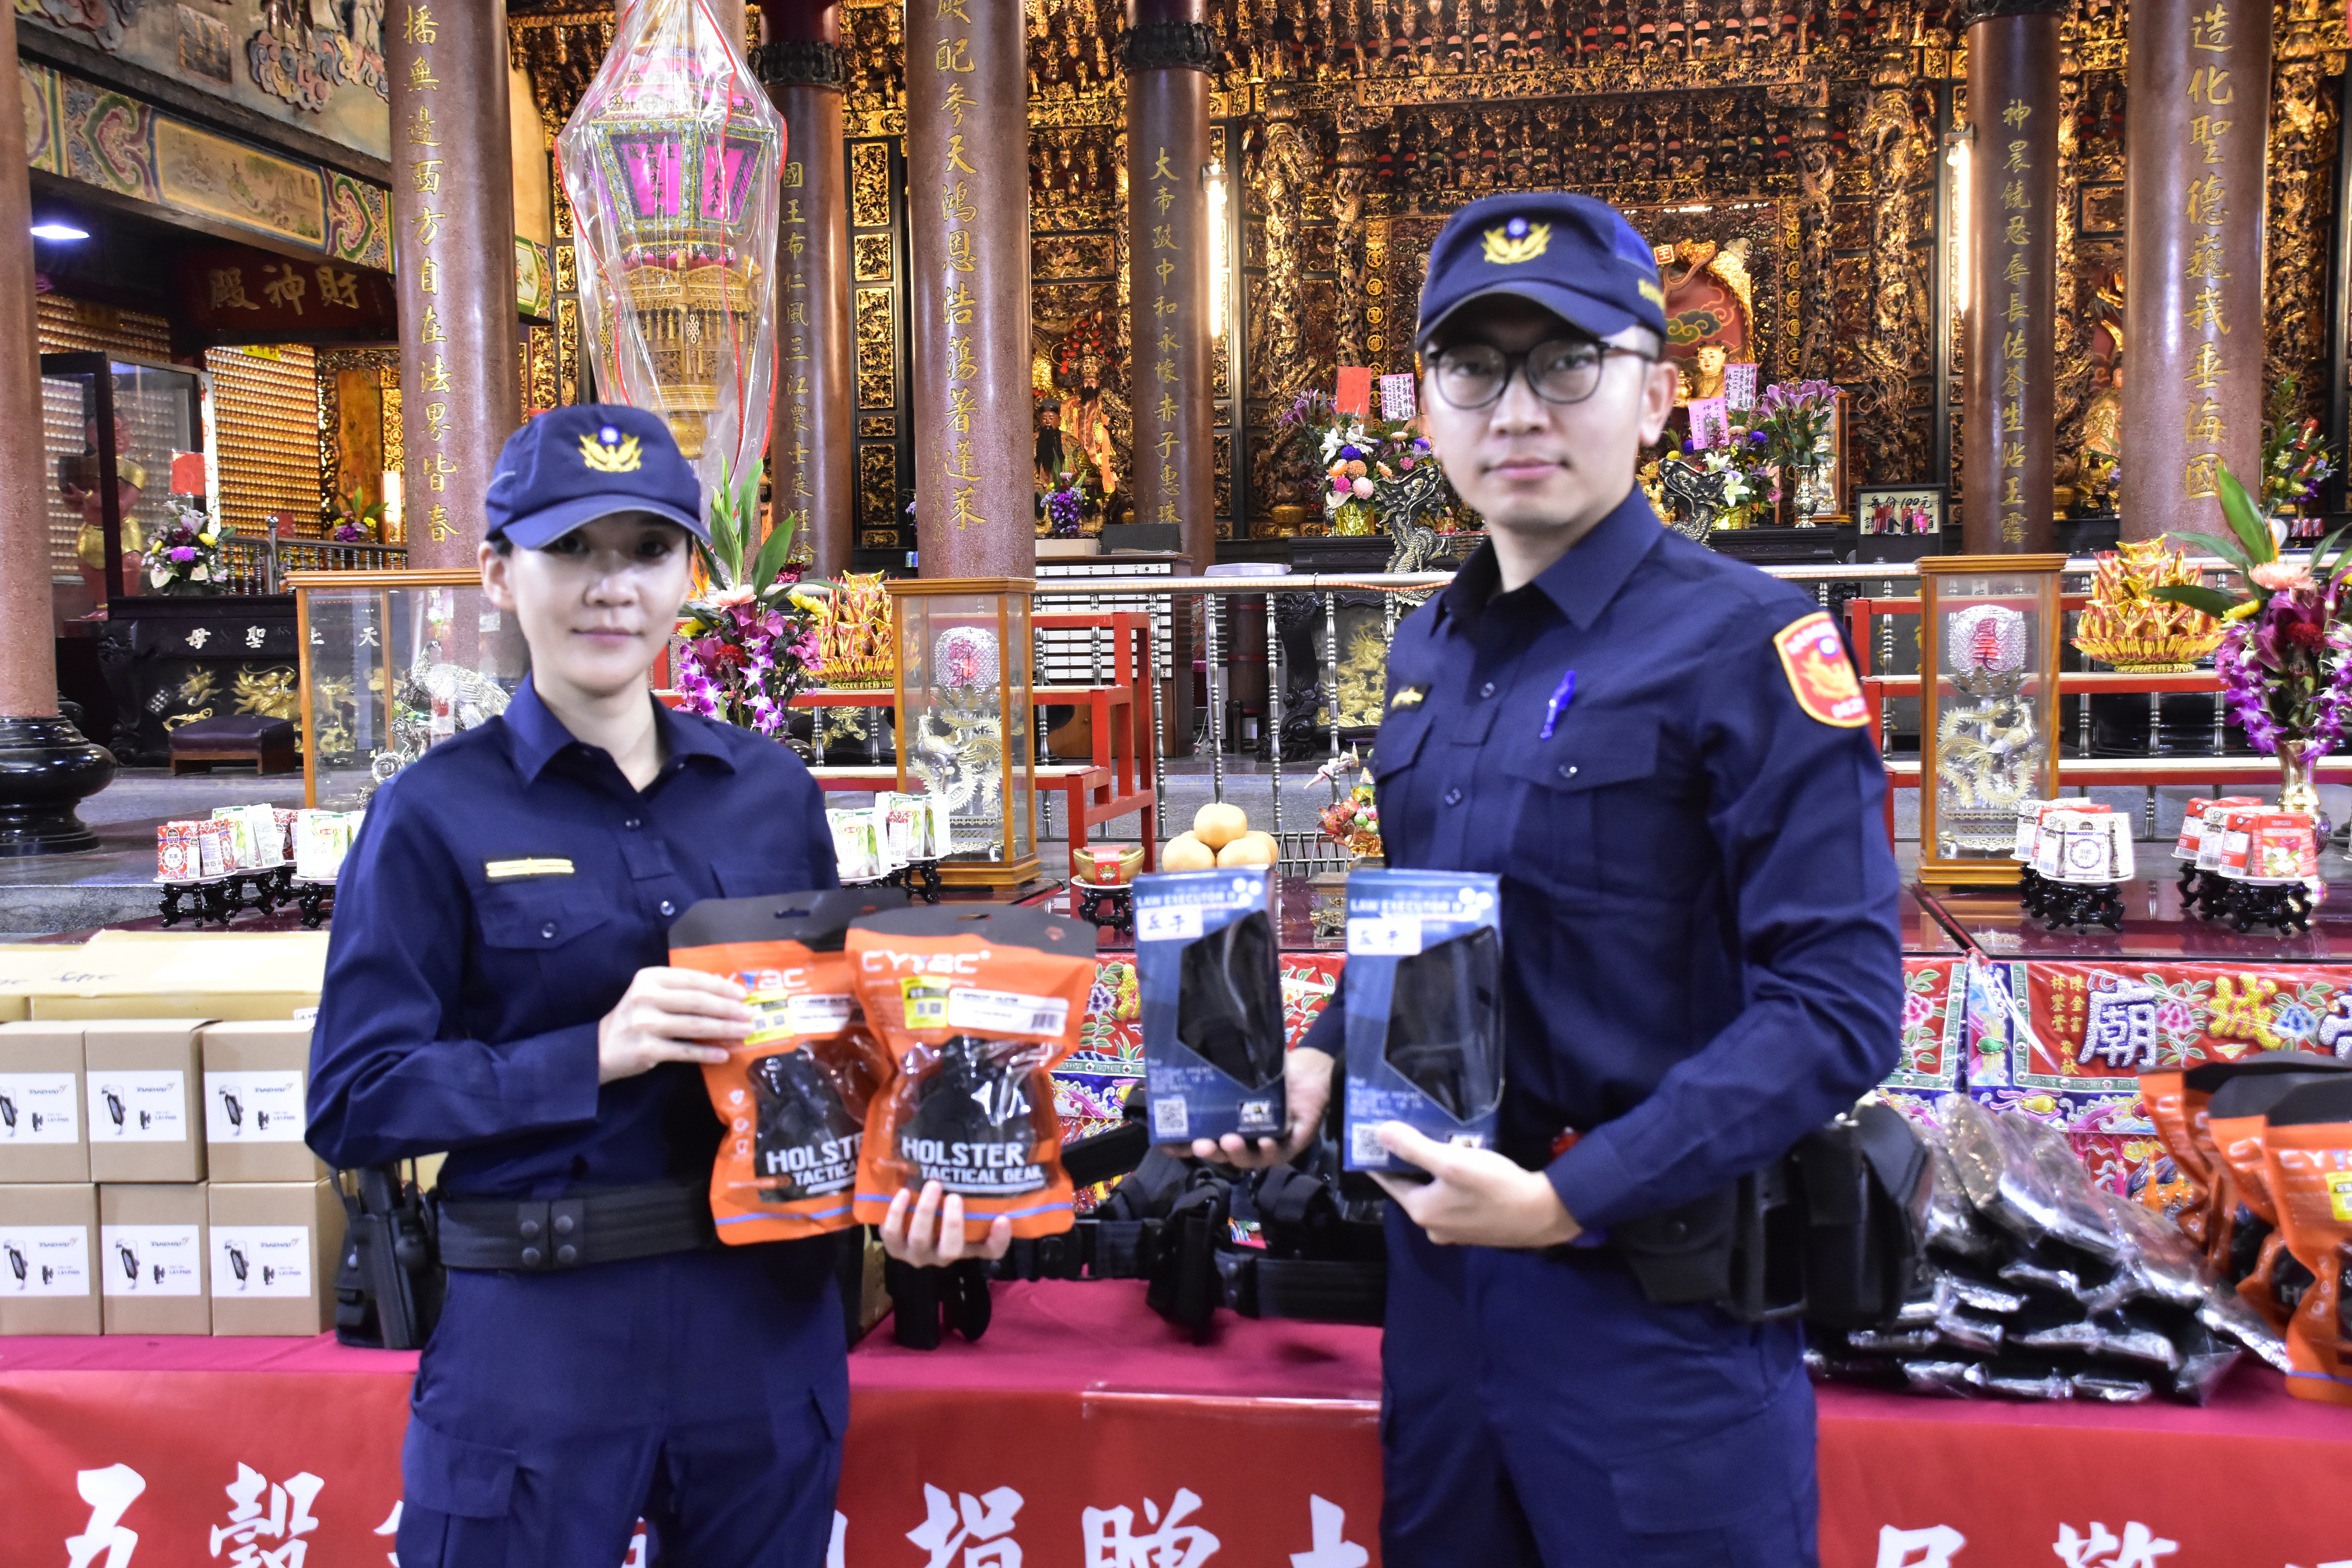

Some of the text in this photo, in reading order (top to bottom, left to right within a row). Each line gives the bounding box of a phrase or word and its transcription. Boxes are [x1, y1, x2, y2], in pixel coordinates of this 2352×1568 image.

[900, 1137, 1024, 1168] HOLSTER
[920, 1165, 1044, 1183] TACTICAL GEAR
